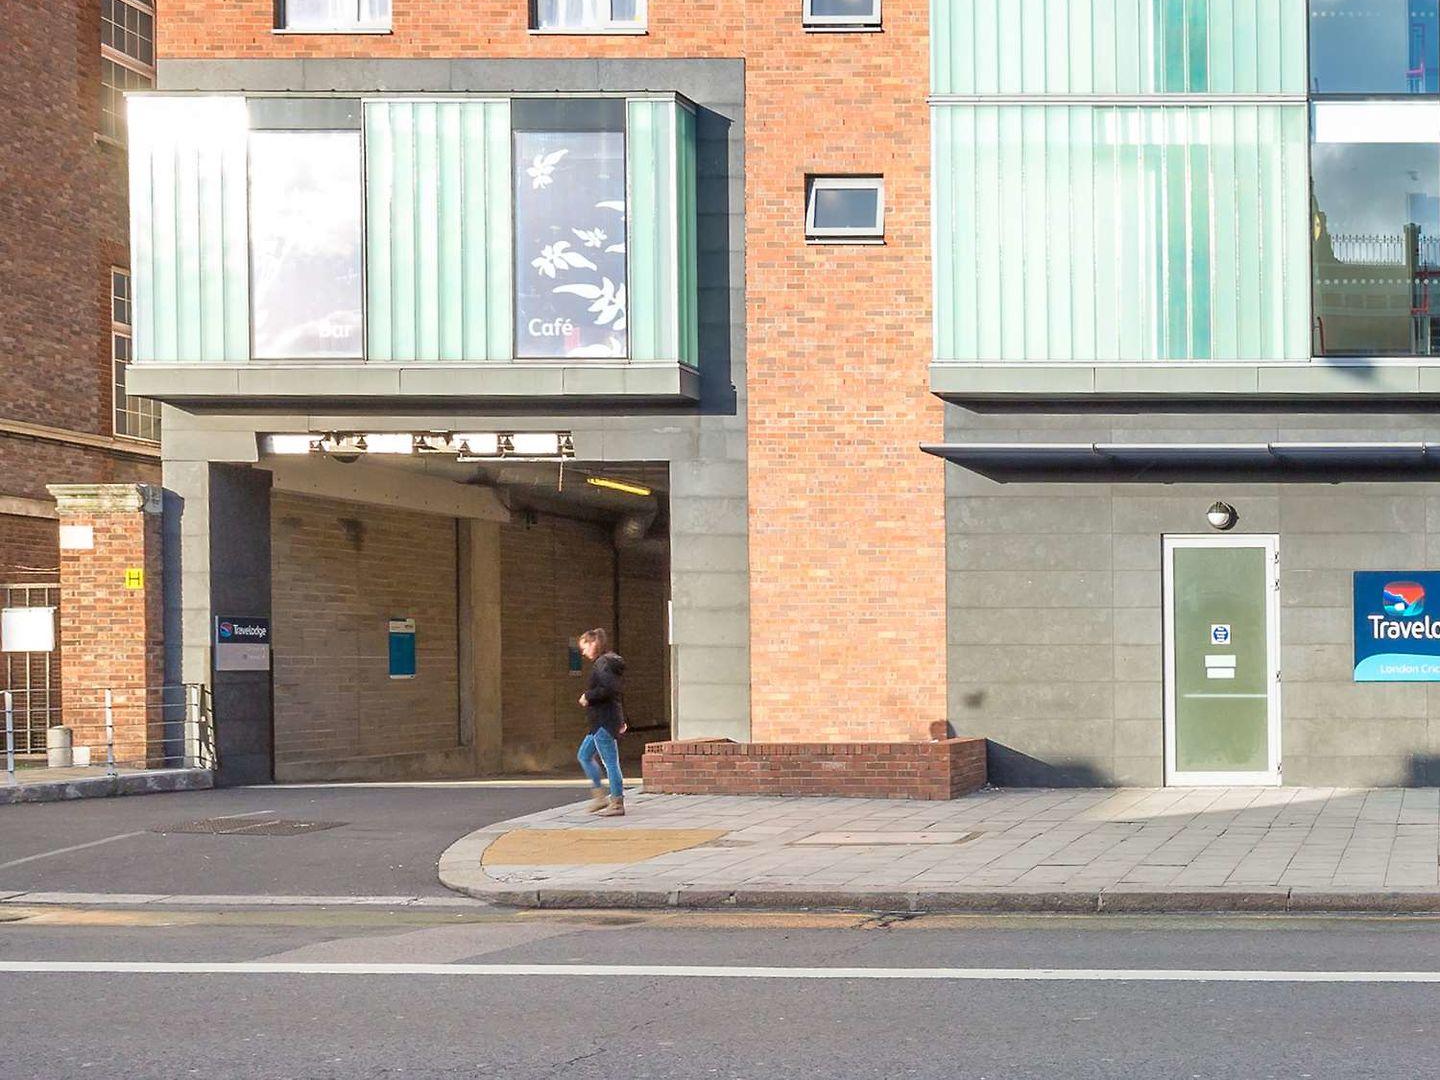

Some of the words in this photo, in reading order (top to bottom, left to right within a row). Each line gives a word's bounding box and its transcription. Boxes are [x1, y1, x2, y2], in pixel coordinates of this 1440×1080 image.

[528, 317, 573, 337] Café
[233, 624, 267, 638] Travelodge
[1380, 664, 1419, 674] London
